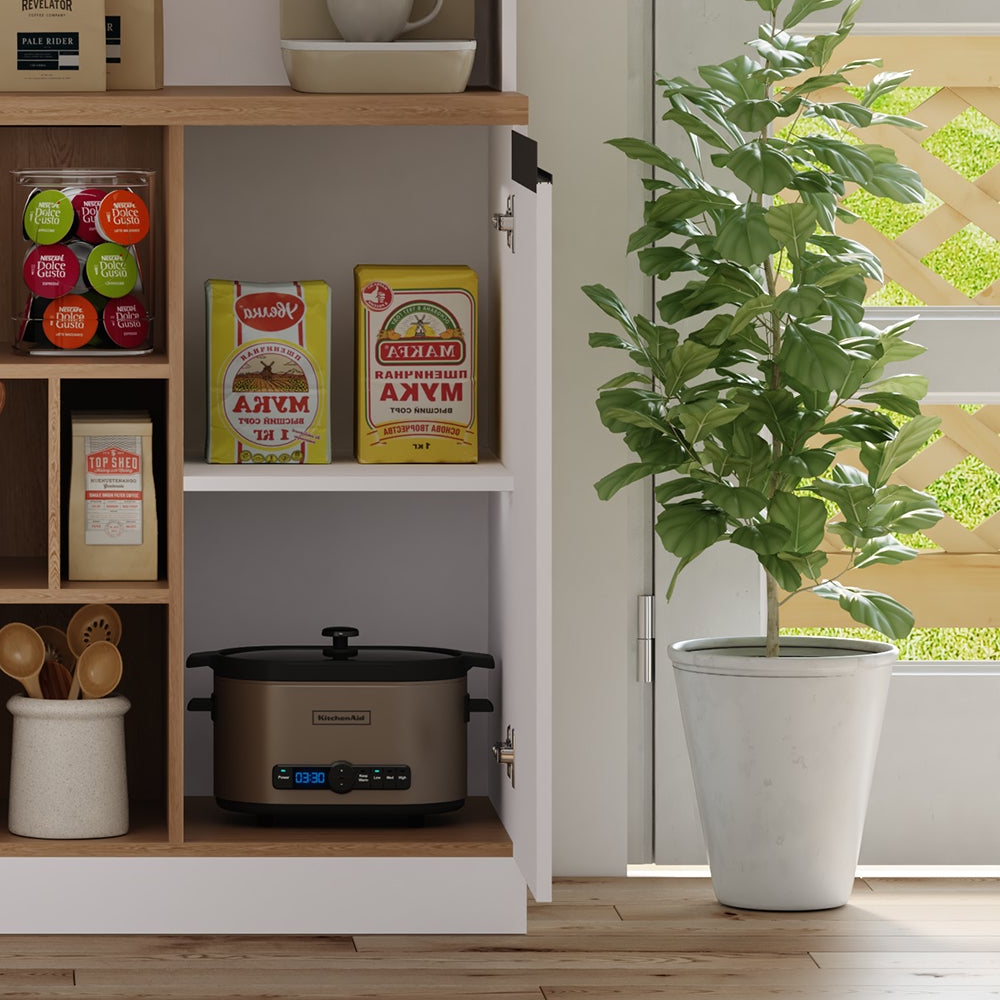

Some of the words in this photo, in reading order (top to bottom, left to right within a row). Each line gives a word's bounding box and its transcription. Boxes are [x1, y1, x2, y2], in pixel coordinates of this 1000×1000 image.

[21, 37, 45, 46] PALE
[46, 37, 74, 46] RIDER
[34, 208, 60, 217] Dolce
[81, 207, 99, 215] Dol
[111, 208, 140, 218] Dolce
[34, 216, 60, 225] Gusto
[113, 216, 140, 225] Gusto
[36, 261, 66, 270] Dolce
[100, 261, 127, 270] Dolce
[36, 269, 66, 278] Gusto
[100, 269, 128, 278] Gusto
[55, 312, 85, 321] Dolce
[115, 311, 140, 321] Dolce
[55, 319, 85, 329] Gusto
[117, 319, 141, 329] Gusto
[89, 456, 108, 469] TOP
[111, 457, 138, 470] SHED
[294, 771, 326, 784] 03:30
